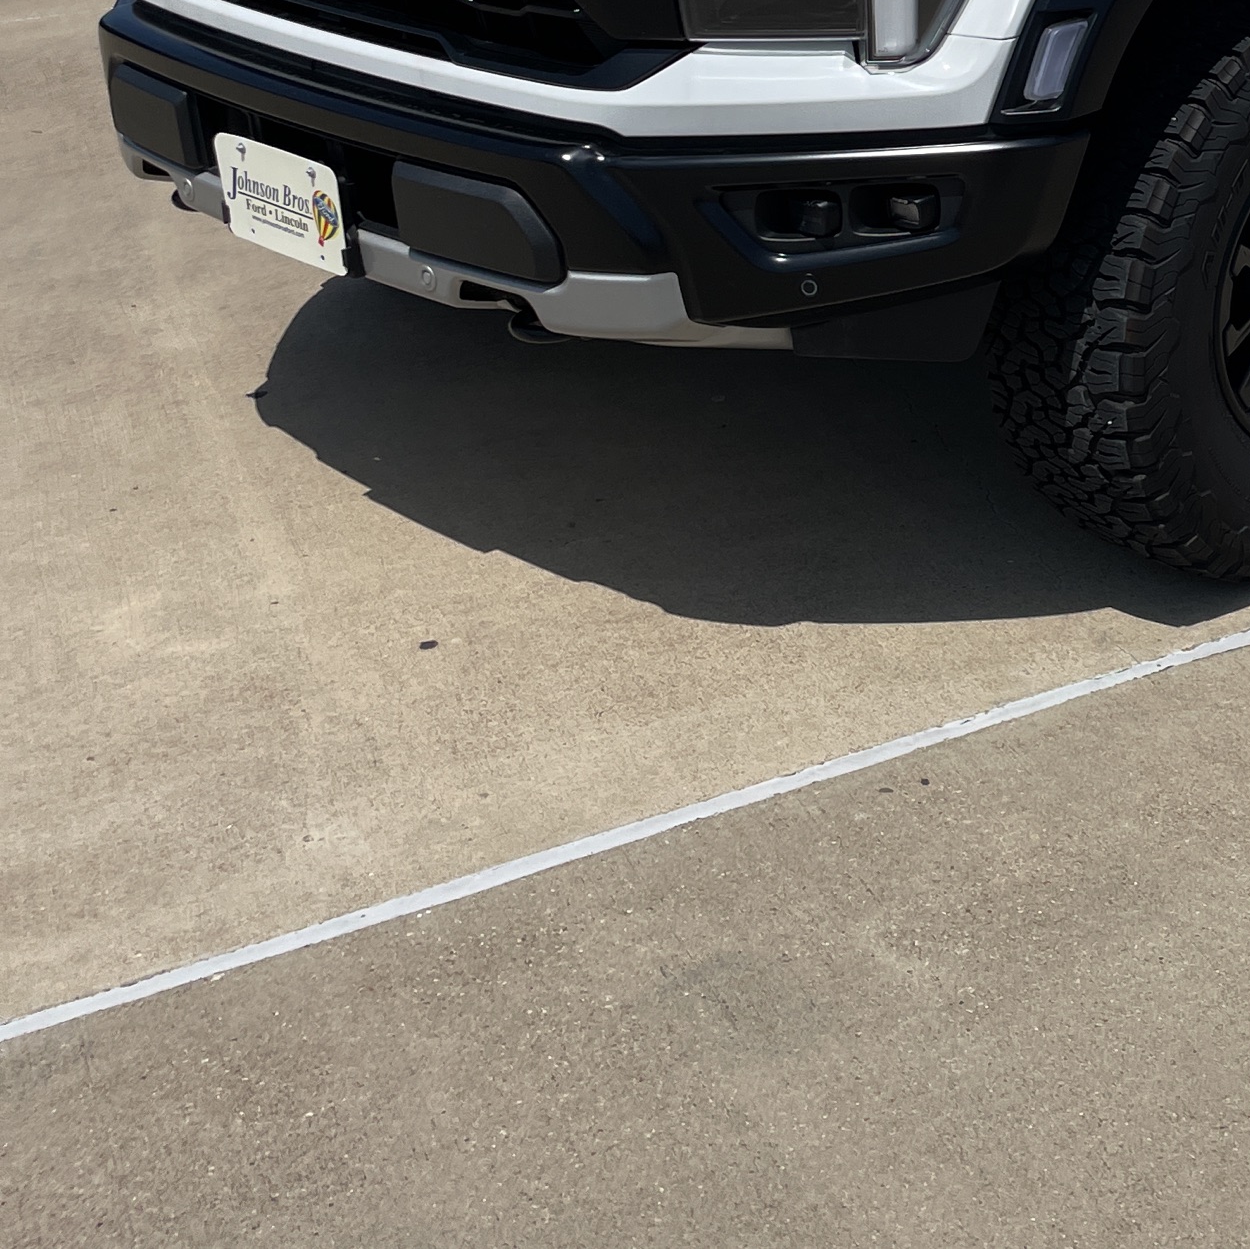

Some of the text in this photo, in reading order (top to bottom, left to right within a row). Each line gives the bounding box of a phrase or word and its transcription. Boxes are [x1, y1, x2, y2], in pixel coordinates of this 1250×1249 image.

[227, 166, 280, 203] Johnson
[246, 198, 267, 217] Ford
[275, 208, 309, 232] Lincoln
